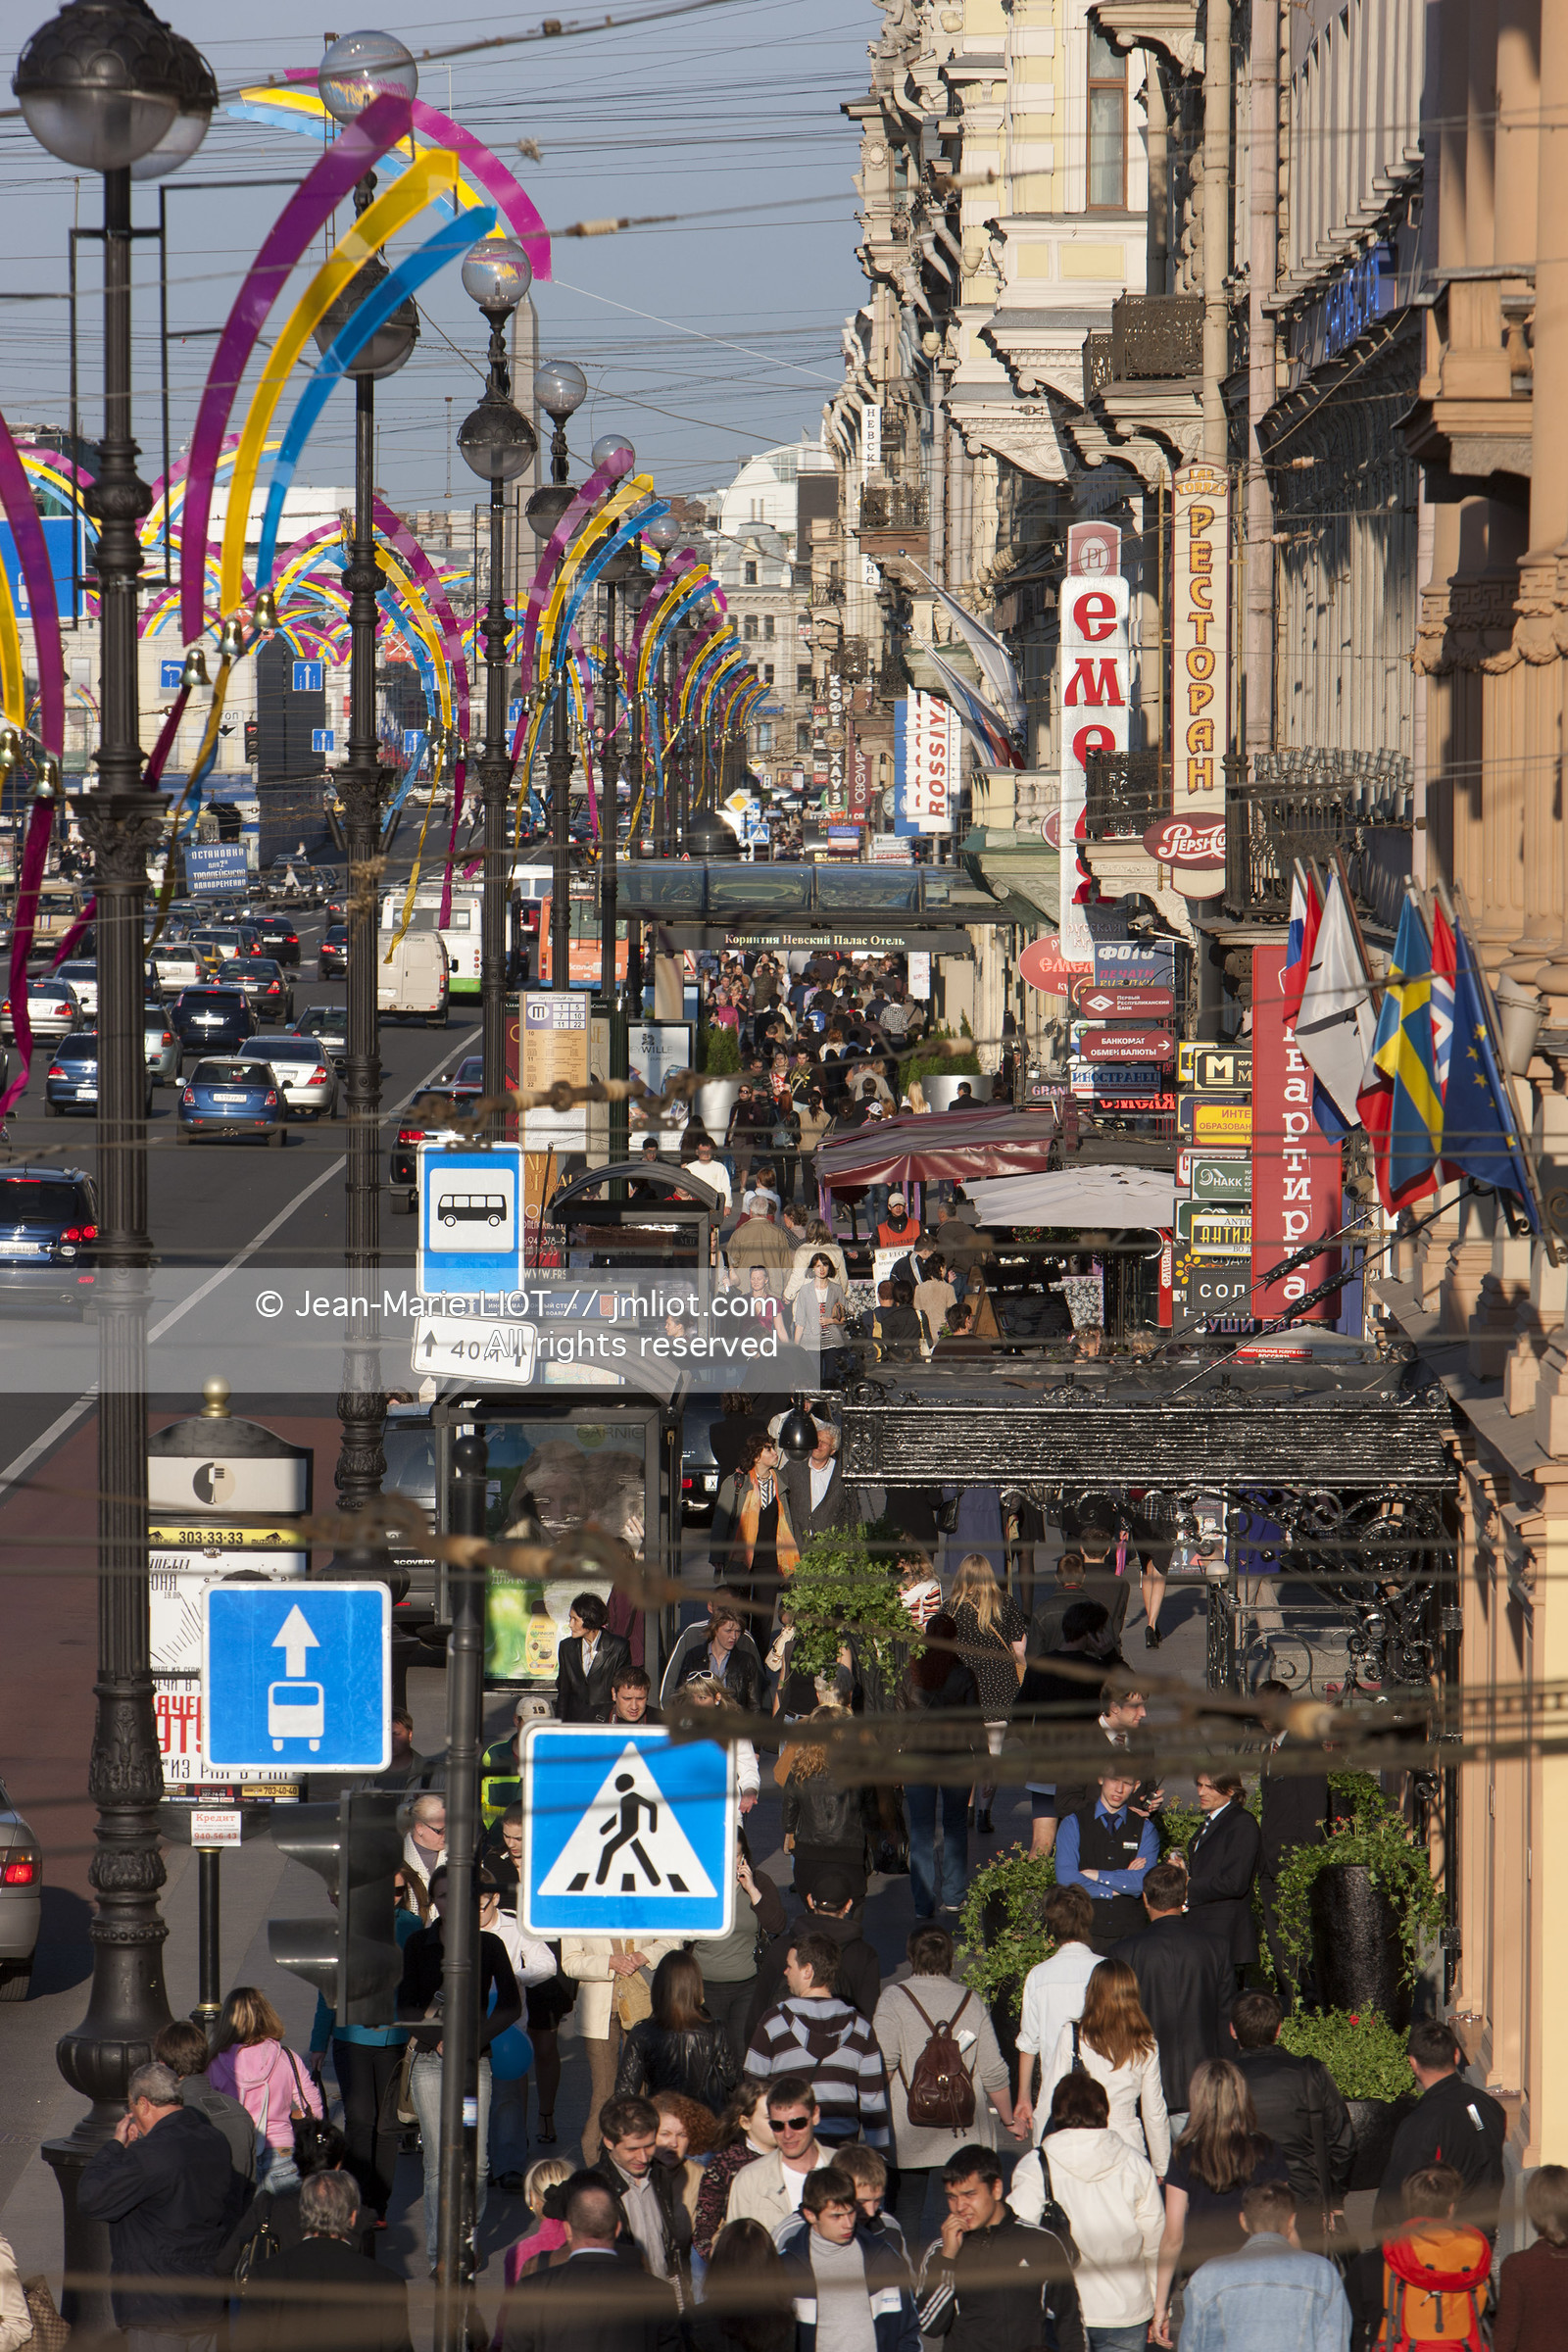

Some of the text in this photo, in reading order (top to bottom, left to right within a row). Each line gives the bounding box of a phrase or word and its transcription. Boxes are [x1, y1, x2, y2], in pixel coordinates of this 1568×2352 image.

[1189, 469, 1214, 480] LAS
[1176, 480, 1227, 496] TORRES
[1186, 505, 1216, 796] РЕСТОРАН
[828, 674, 843, 726] КОФЕ
[929, 695, 947, 818] ROSSIYA
[829, 753, 843, 804] ХАУЗ
[191, 848, 244, 859] ОСТАНОВКА
[724, 934, 906, 946] Коринтия Невский Палас Отель
[1100, 969, 1155, 979] ПЕЧАТИ
[1072, 1071, 1160, 1083] ИНОСТРАНЕЦ
[264, 1787, 298, 1795] 703-40-40
[196, 1813, 236, 1823] Кредит
